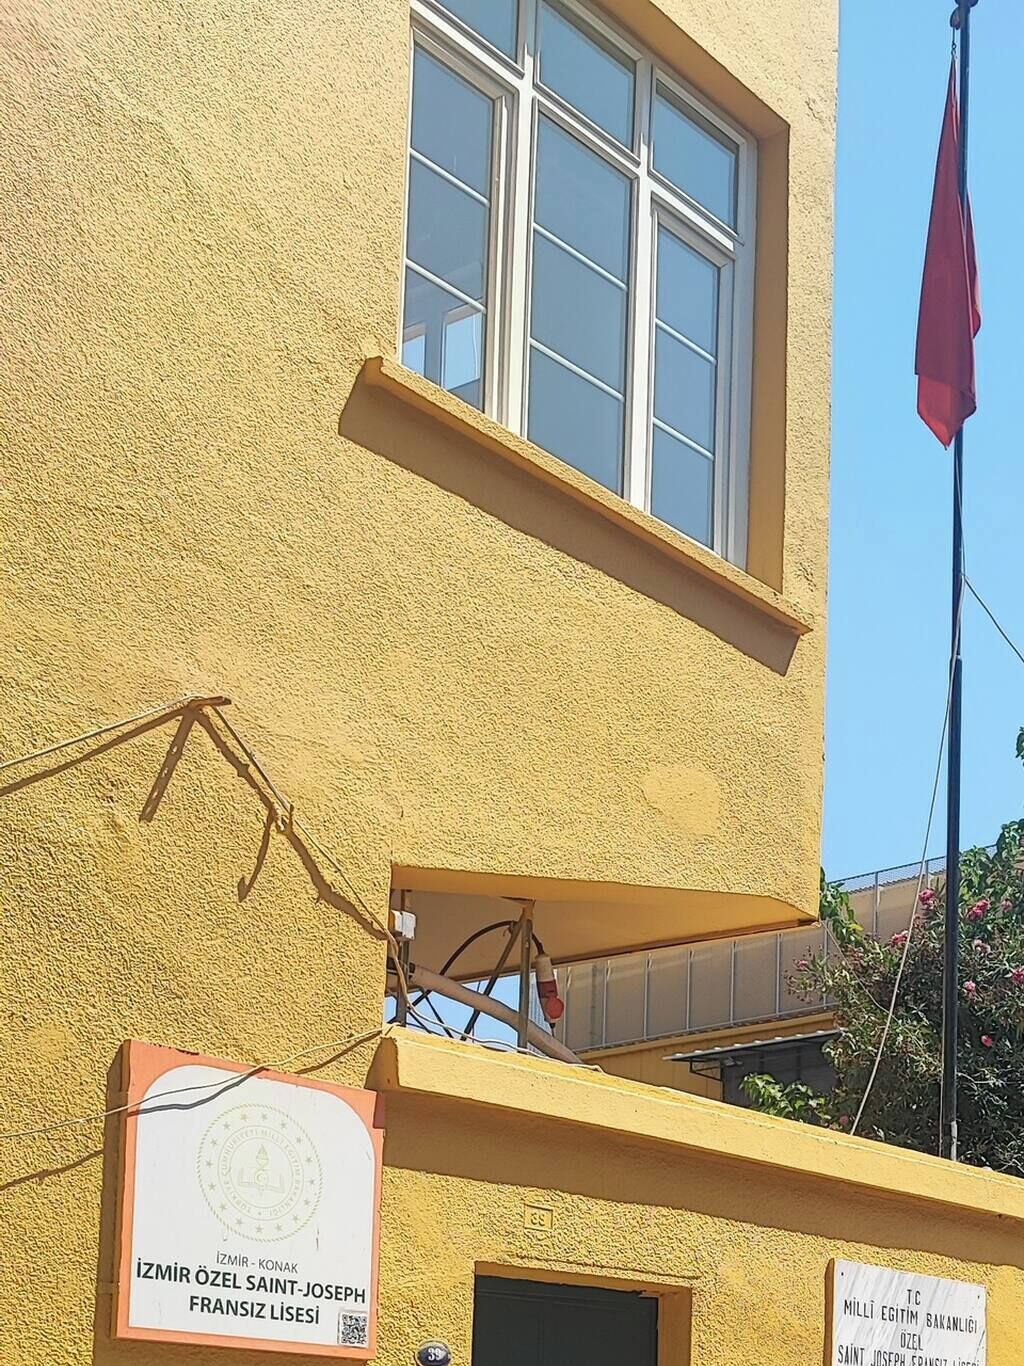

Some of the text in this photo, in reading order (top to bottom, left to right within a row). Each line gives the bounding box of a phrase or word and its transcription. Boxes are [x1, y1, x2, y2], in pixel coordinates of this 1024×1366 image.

[216, 1250, 249, 1268] İZMİR
[258, 1258, 298, 1274] KONAK
[136, 1257, 366, 1304] İZMİR ÖZEL SAINT-JOSEPH
[189, 1295, 320, 1325] FRANSIZ LİSESİ
[926, 1312, 977, 1334] BAKANLIĞI
[900, 1328, 924, 1351] ÖZEL
[428, 1347, 444, 1361] 39
